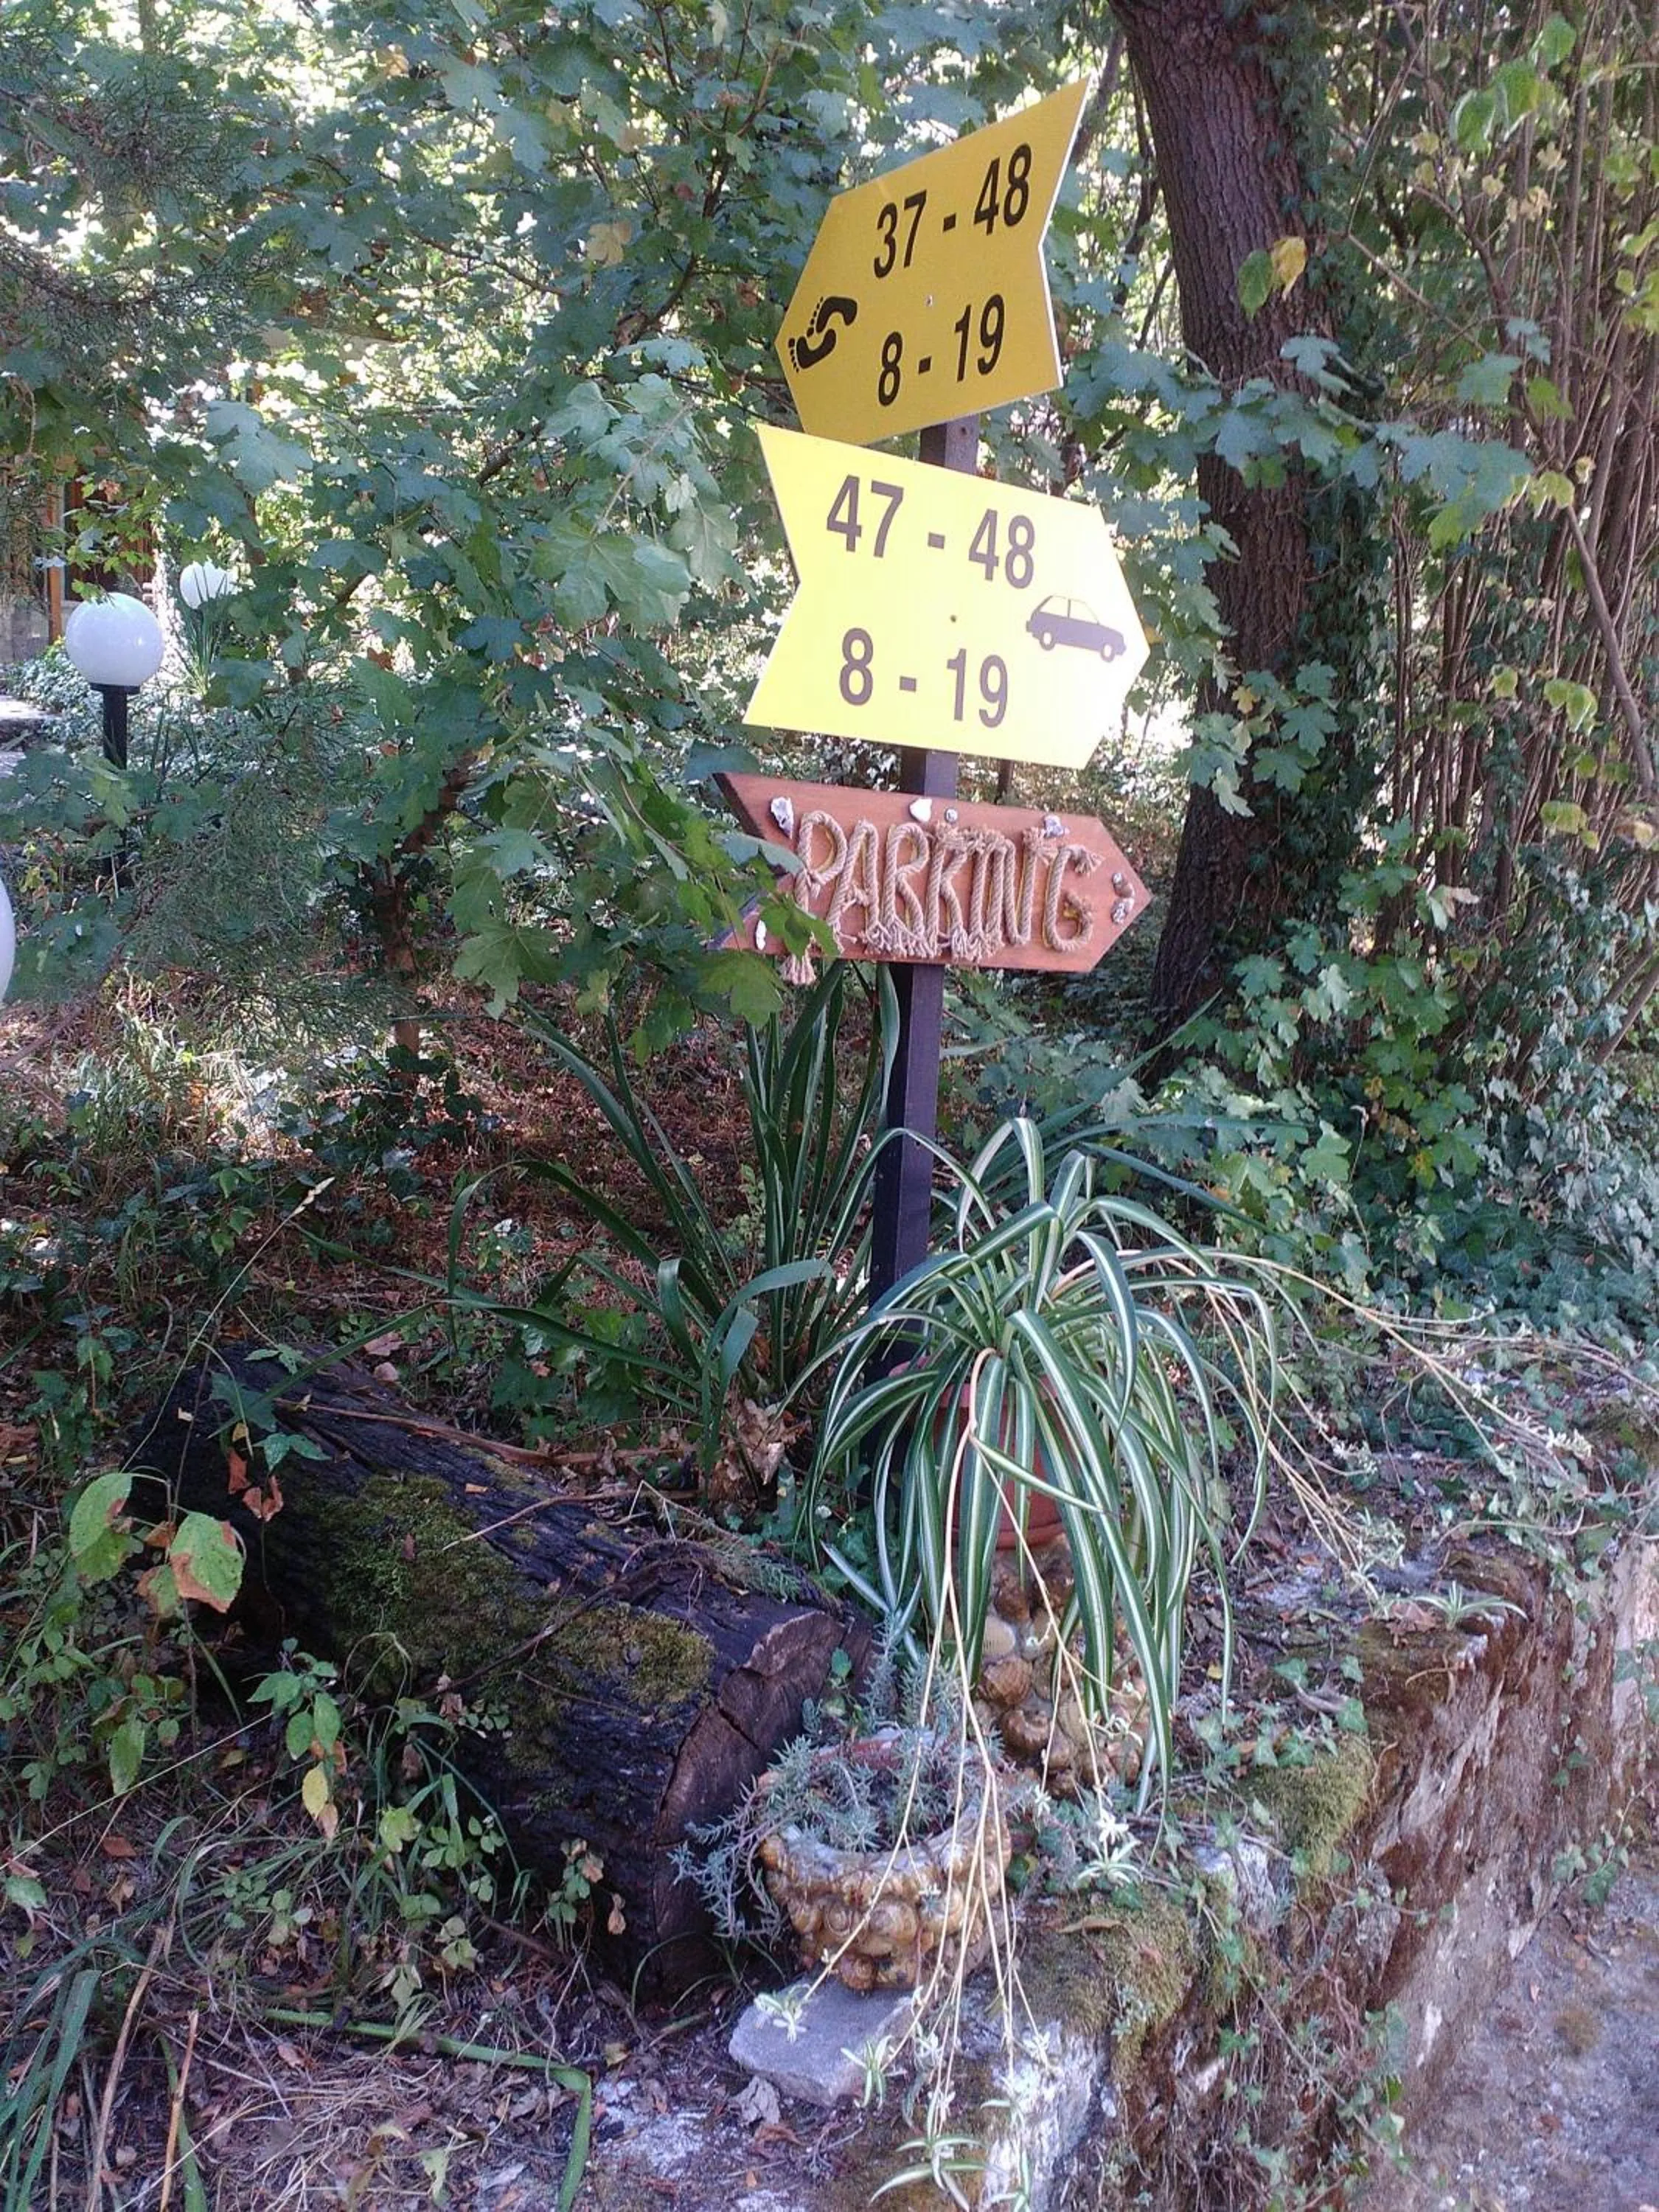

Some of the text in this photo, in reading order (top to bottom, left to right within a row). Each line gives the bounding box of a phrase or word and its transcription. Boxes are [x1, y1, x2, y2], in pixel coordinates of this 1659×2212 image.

[874, 189, 928, 279] 37
[973, 143, 1032, 235] 48
[877, 331, 903, 406] 8
[954, 294, 1006, 383] 19
[826, 474, 905, 558] 47
[967, 509, 1035, 589] 48
[839, 627, 874, 706] 8
[946, 648, 1008, 728] 19
[786, 810, 1103, 967] PARKING
